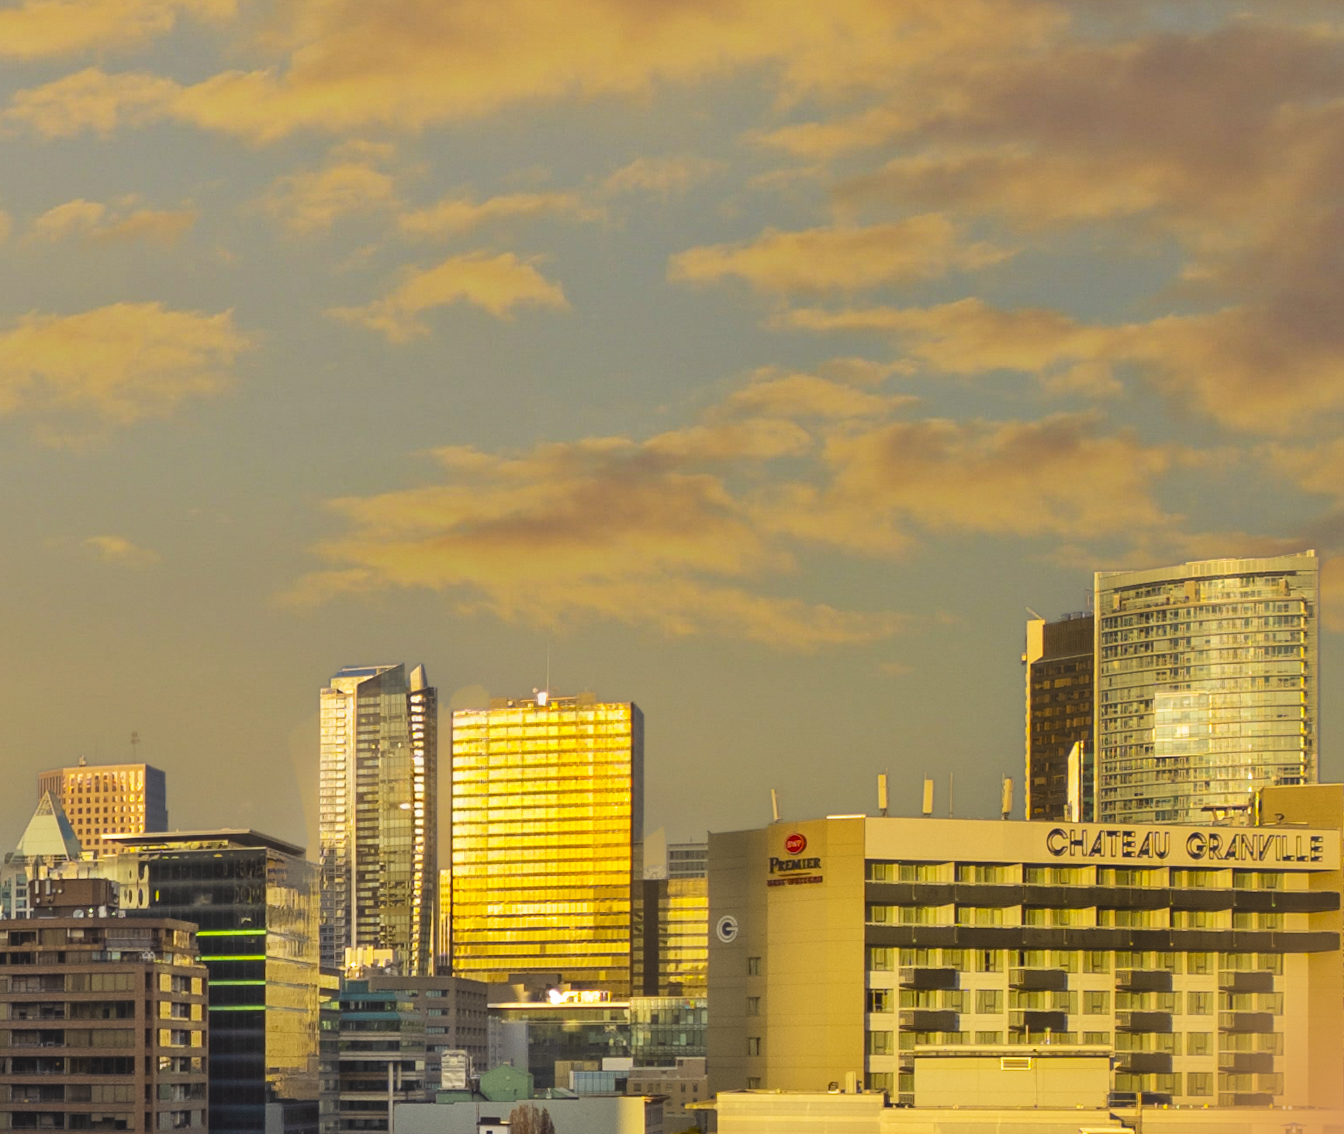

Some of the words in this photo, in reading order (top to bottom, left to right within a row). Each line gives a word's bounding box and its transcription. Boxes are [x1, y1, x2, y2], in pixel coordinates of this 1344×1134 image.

[1046, 828, 1170, 859] CHATEAU
[1186, 831, 1324, 863] GRANVILLE
[769, 857, 822, 874] PREMIER
